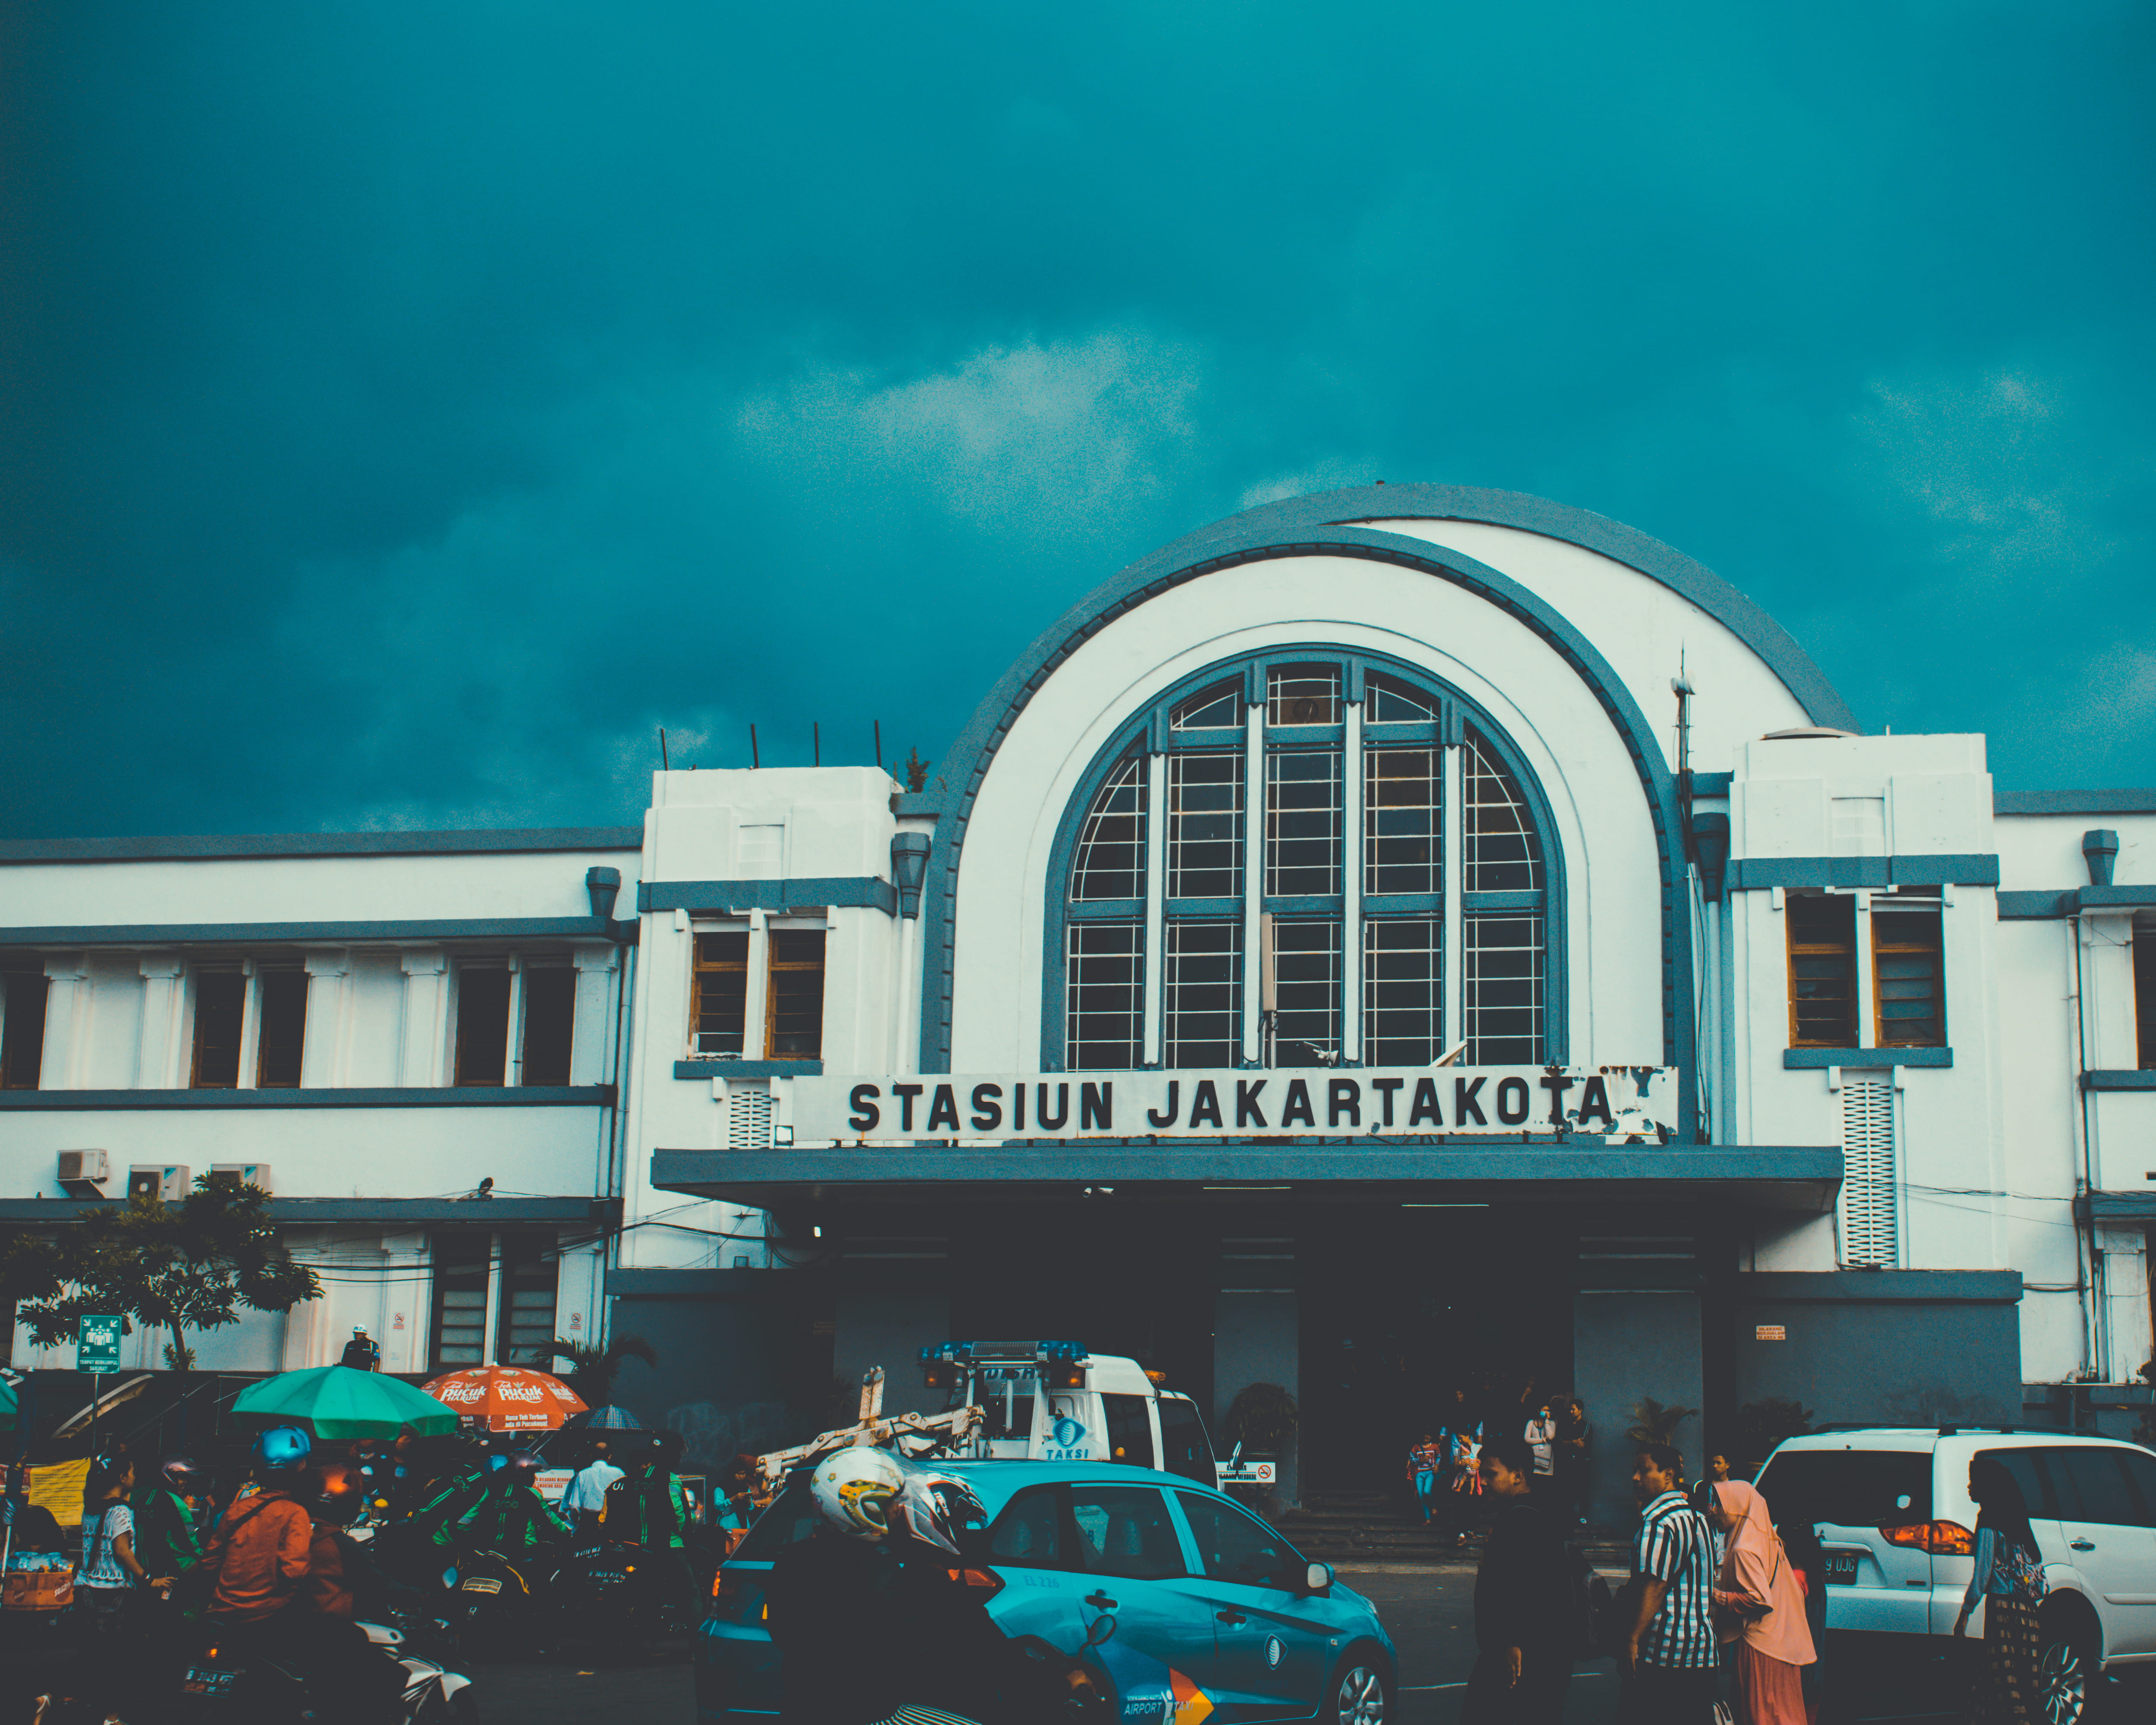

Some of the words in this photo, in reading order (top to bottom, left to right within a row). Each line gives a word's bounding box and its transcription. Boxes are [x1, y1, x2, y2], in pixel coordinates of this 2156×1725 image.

[848, 1082, 1112, 1132] STASIUN
[1147, 1076, 1613, 1129] JAKARTAKOTA
[493, 1380, 512, 1388] Teh
[1046, 1449, 1089, 1460] TAKSI
[1836, 1558, 1855, 1572] UJG
[1124, 1702, 1163, 1715] AIRPORT
[1174, 1700, 1194, 1712] TAXI
